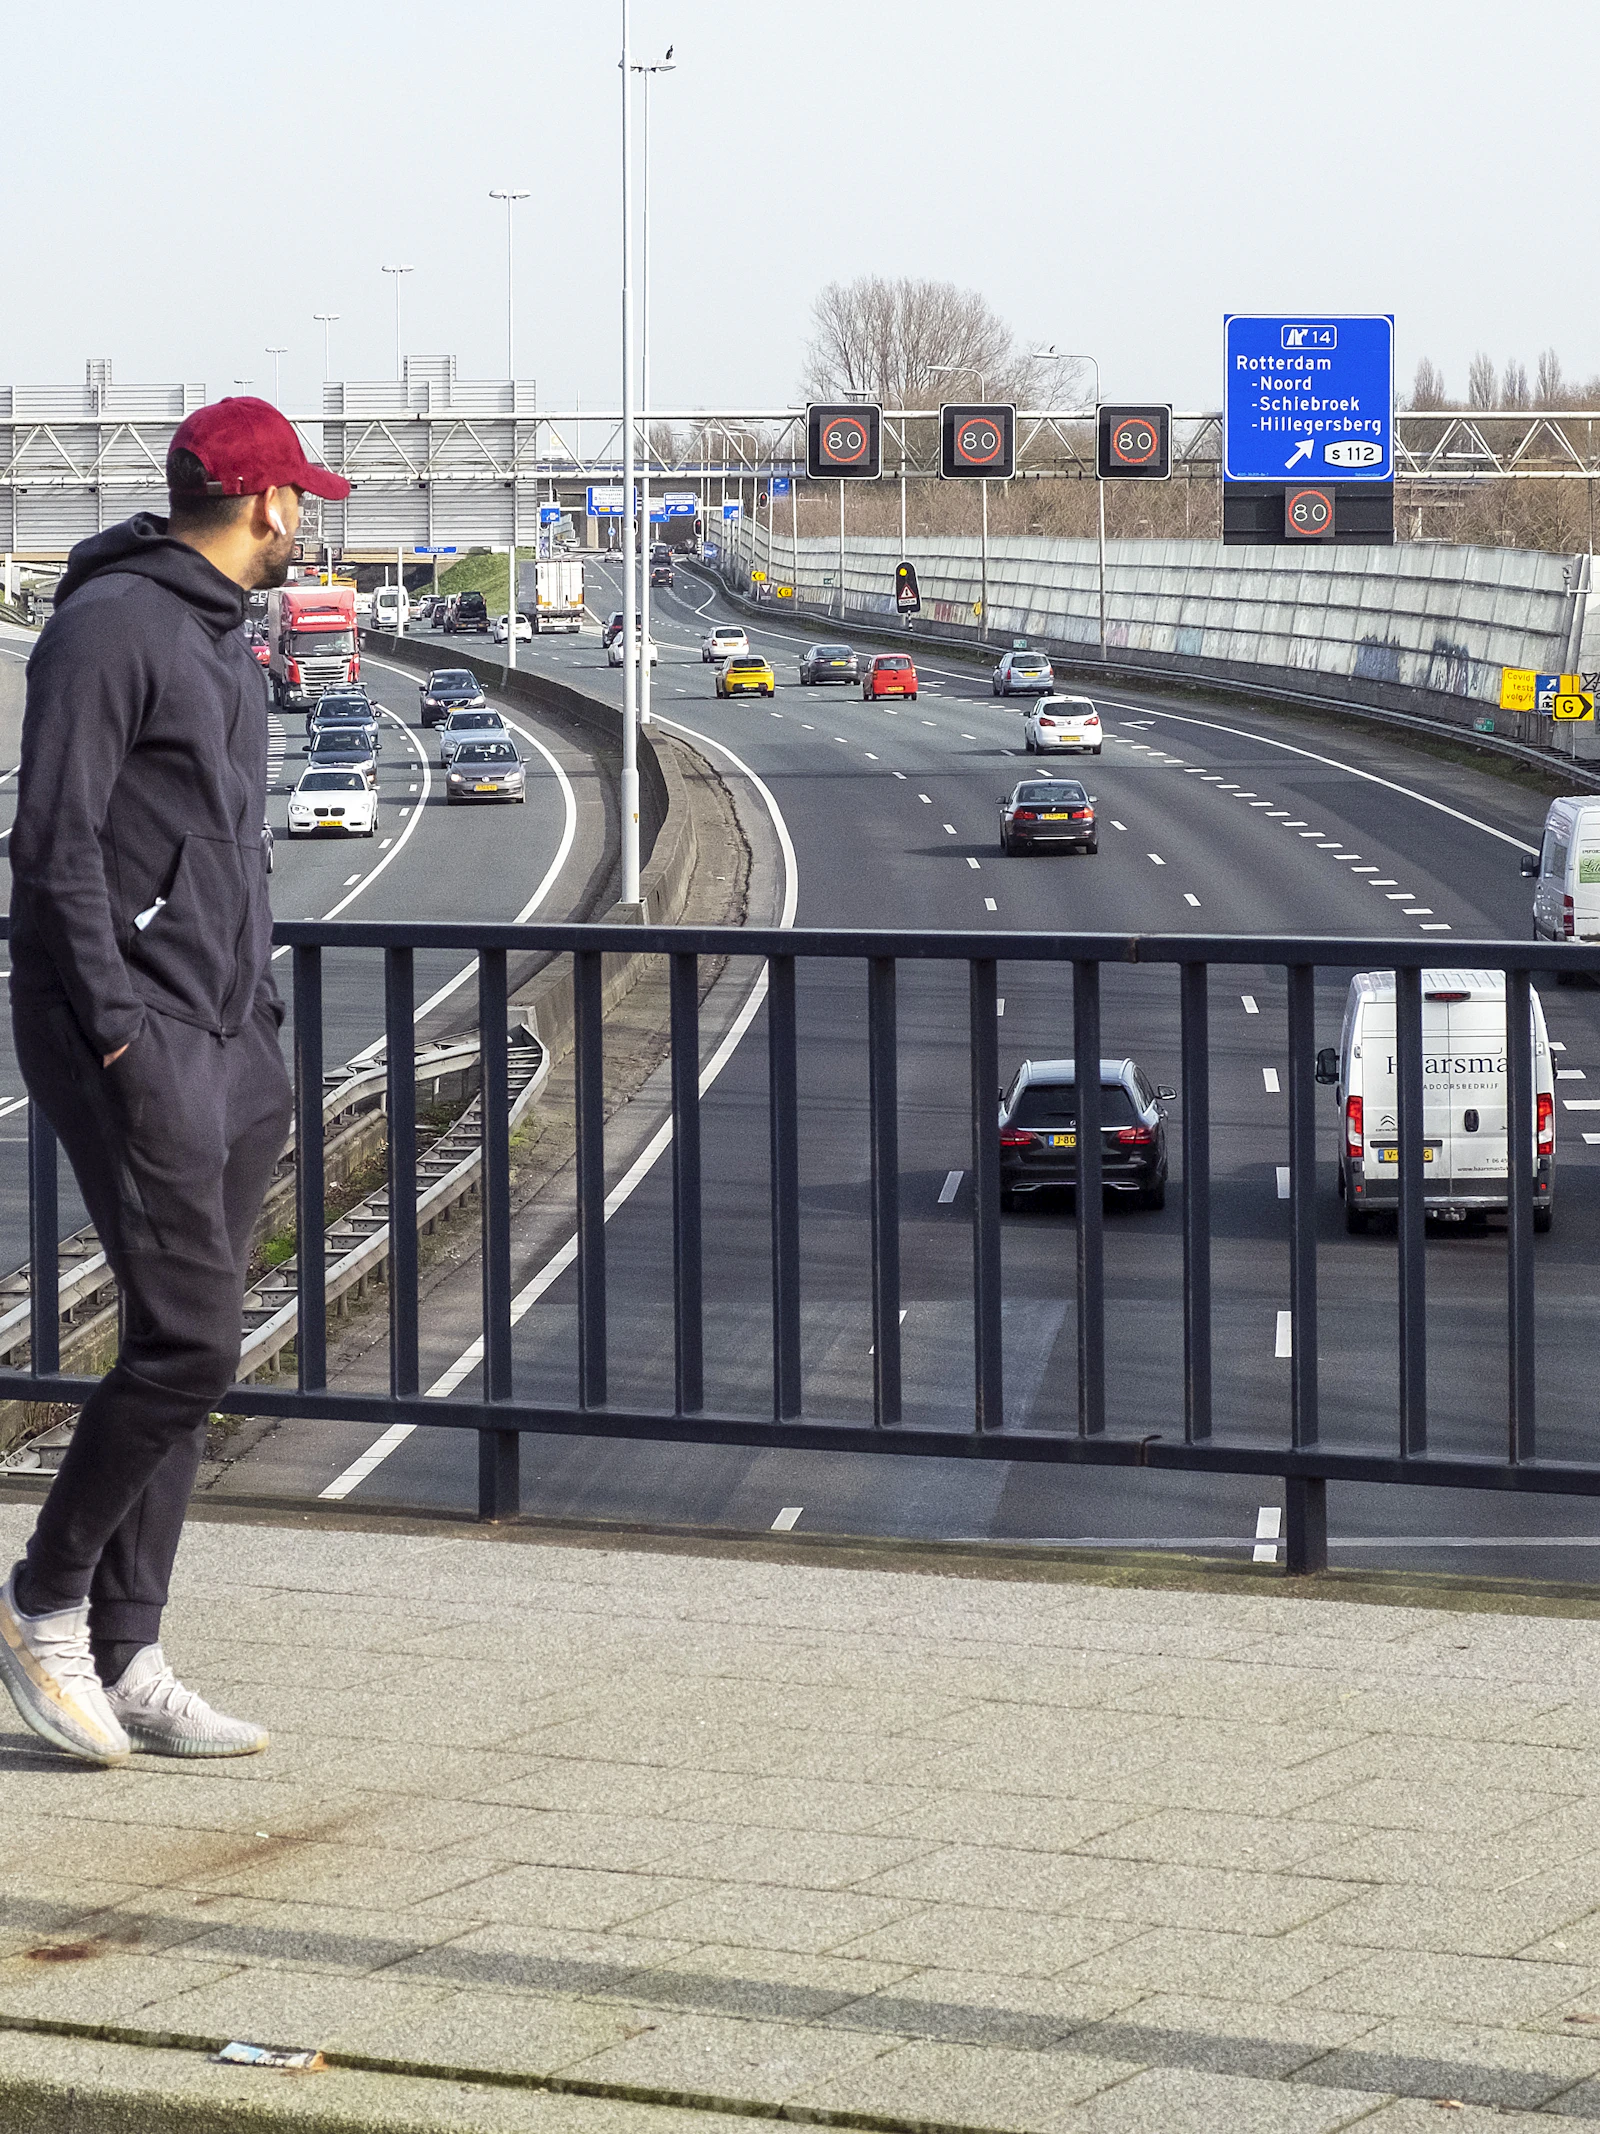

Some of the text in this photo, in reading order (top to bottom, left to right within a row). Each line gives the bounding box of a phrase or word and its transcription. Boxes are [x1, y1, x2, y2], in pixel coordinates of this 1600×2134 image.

[1312, 331, 1331, 344] 14
[1236, 355, 1332, 371] Rotterdam
[828, 431, 862, 449] 80
[962, 432, 995, 449] 80
[1119, 432, 1152, 450] 80
[1293, 504, 1327, 522] 80
[1507, 672, 1531, 682] Covid
[1562, 699, 1574, 714] G
